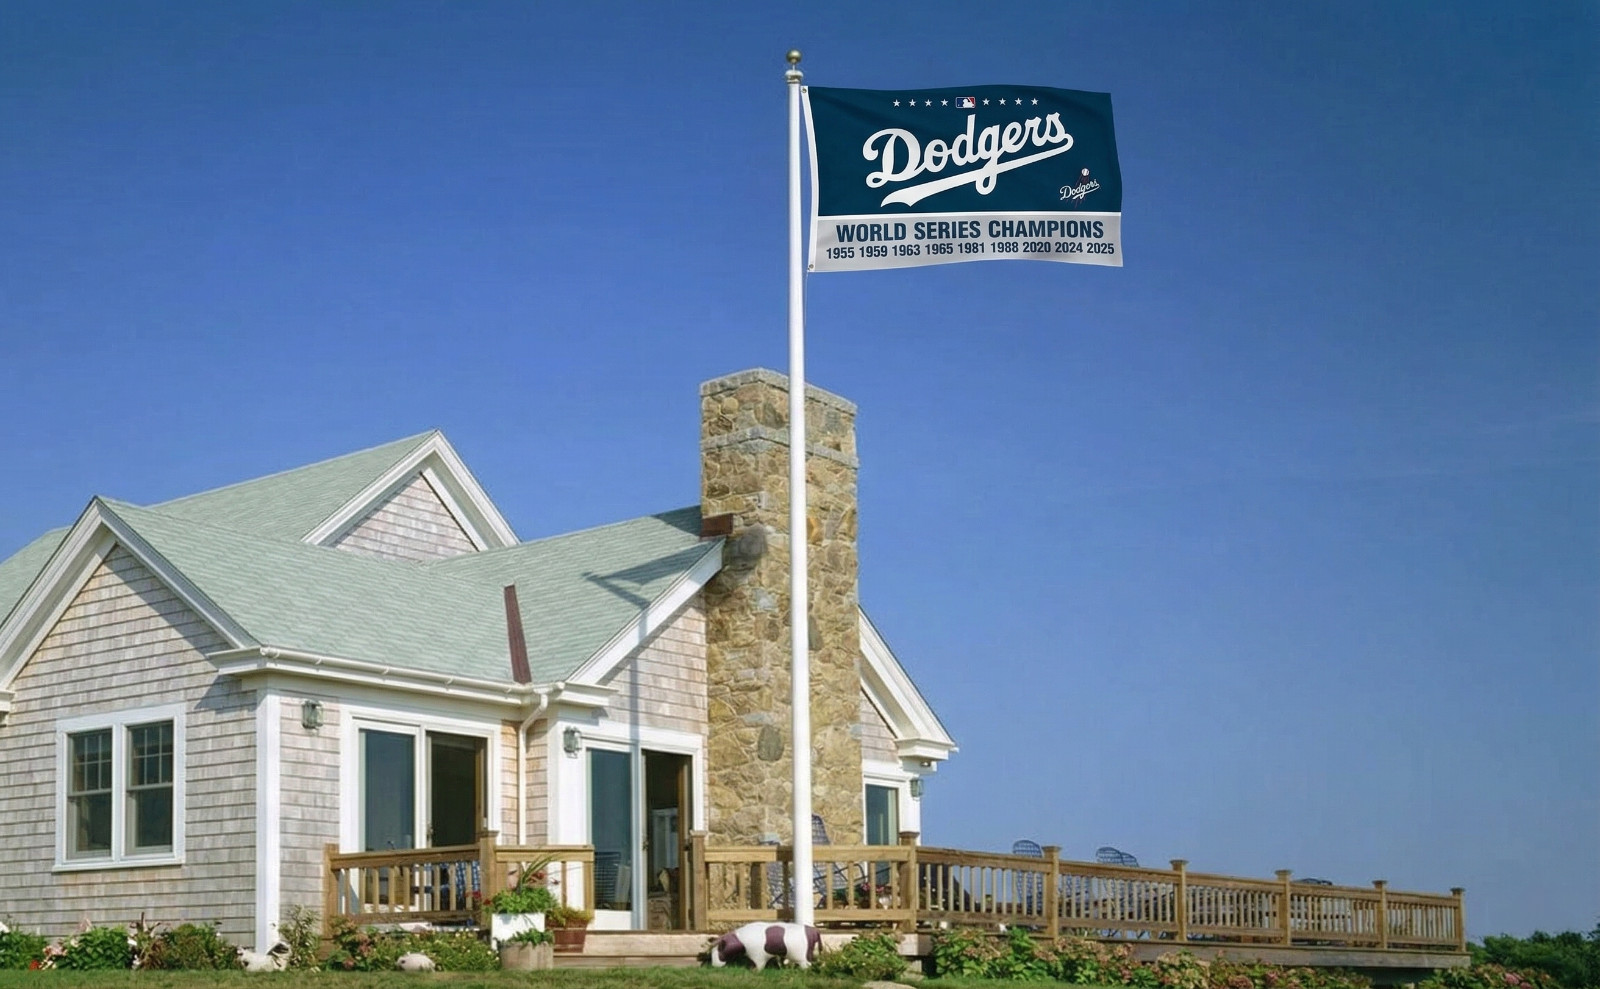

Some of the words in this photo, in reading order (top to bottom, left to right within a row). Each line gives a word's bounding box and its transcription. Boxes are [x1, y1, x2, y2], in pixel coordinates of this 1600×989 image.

[862, 111, 1074, 207] Dodgers
[835, 223, 907, 243] WORLD
[913, 220, 981, 241] SERIES
[988, 219, 1104, 239] CHAMPIONS
[826, 246, 855, 260] 1955
[858, 245, 888, 258] 1959
[891, 243, 921, 257] 1963
[924, 242, 954, 256] 1965
[957, 241, 986, 254] 1981
[990, 241, 1019, 254] 1988
[1022, 241, 1052, 254] 2020
[1054, 241, 1084, 254] 2024
[1086, 242, 1116, 255] 2025
